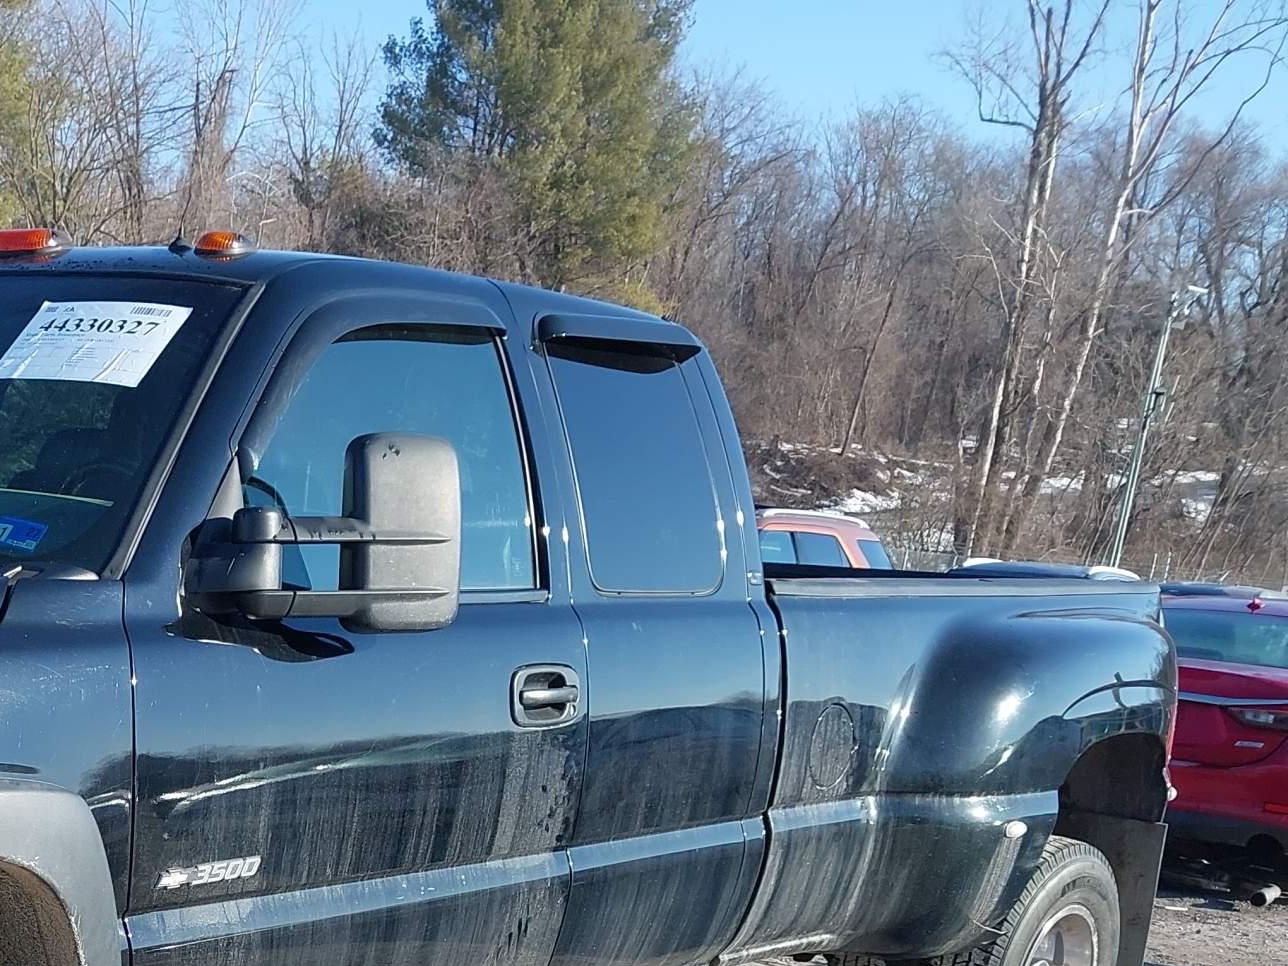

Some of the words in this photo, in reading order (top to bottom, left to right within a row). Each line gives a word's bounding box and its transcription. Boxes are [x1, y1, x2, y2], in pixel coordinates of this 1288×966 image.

[39, 317, 161, 336] 44330327
[0, 526, 7, 539] 1
[191, 855, 262, 886] 3500
